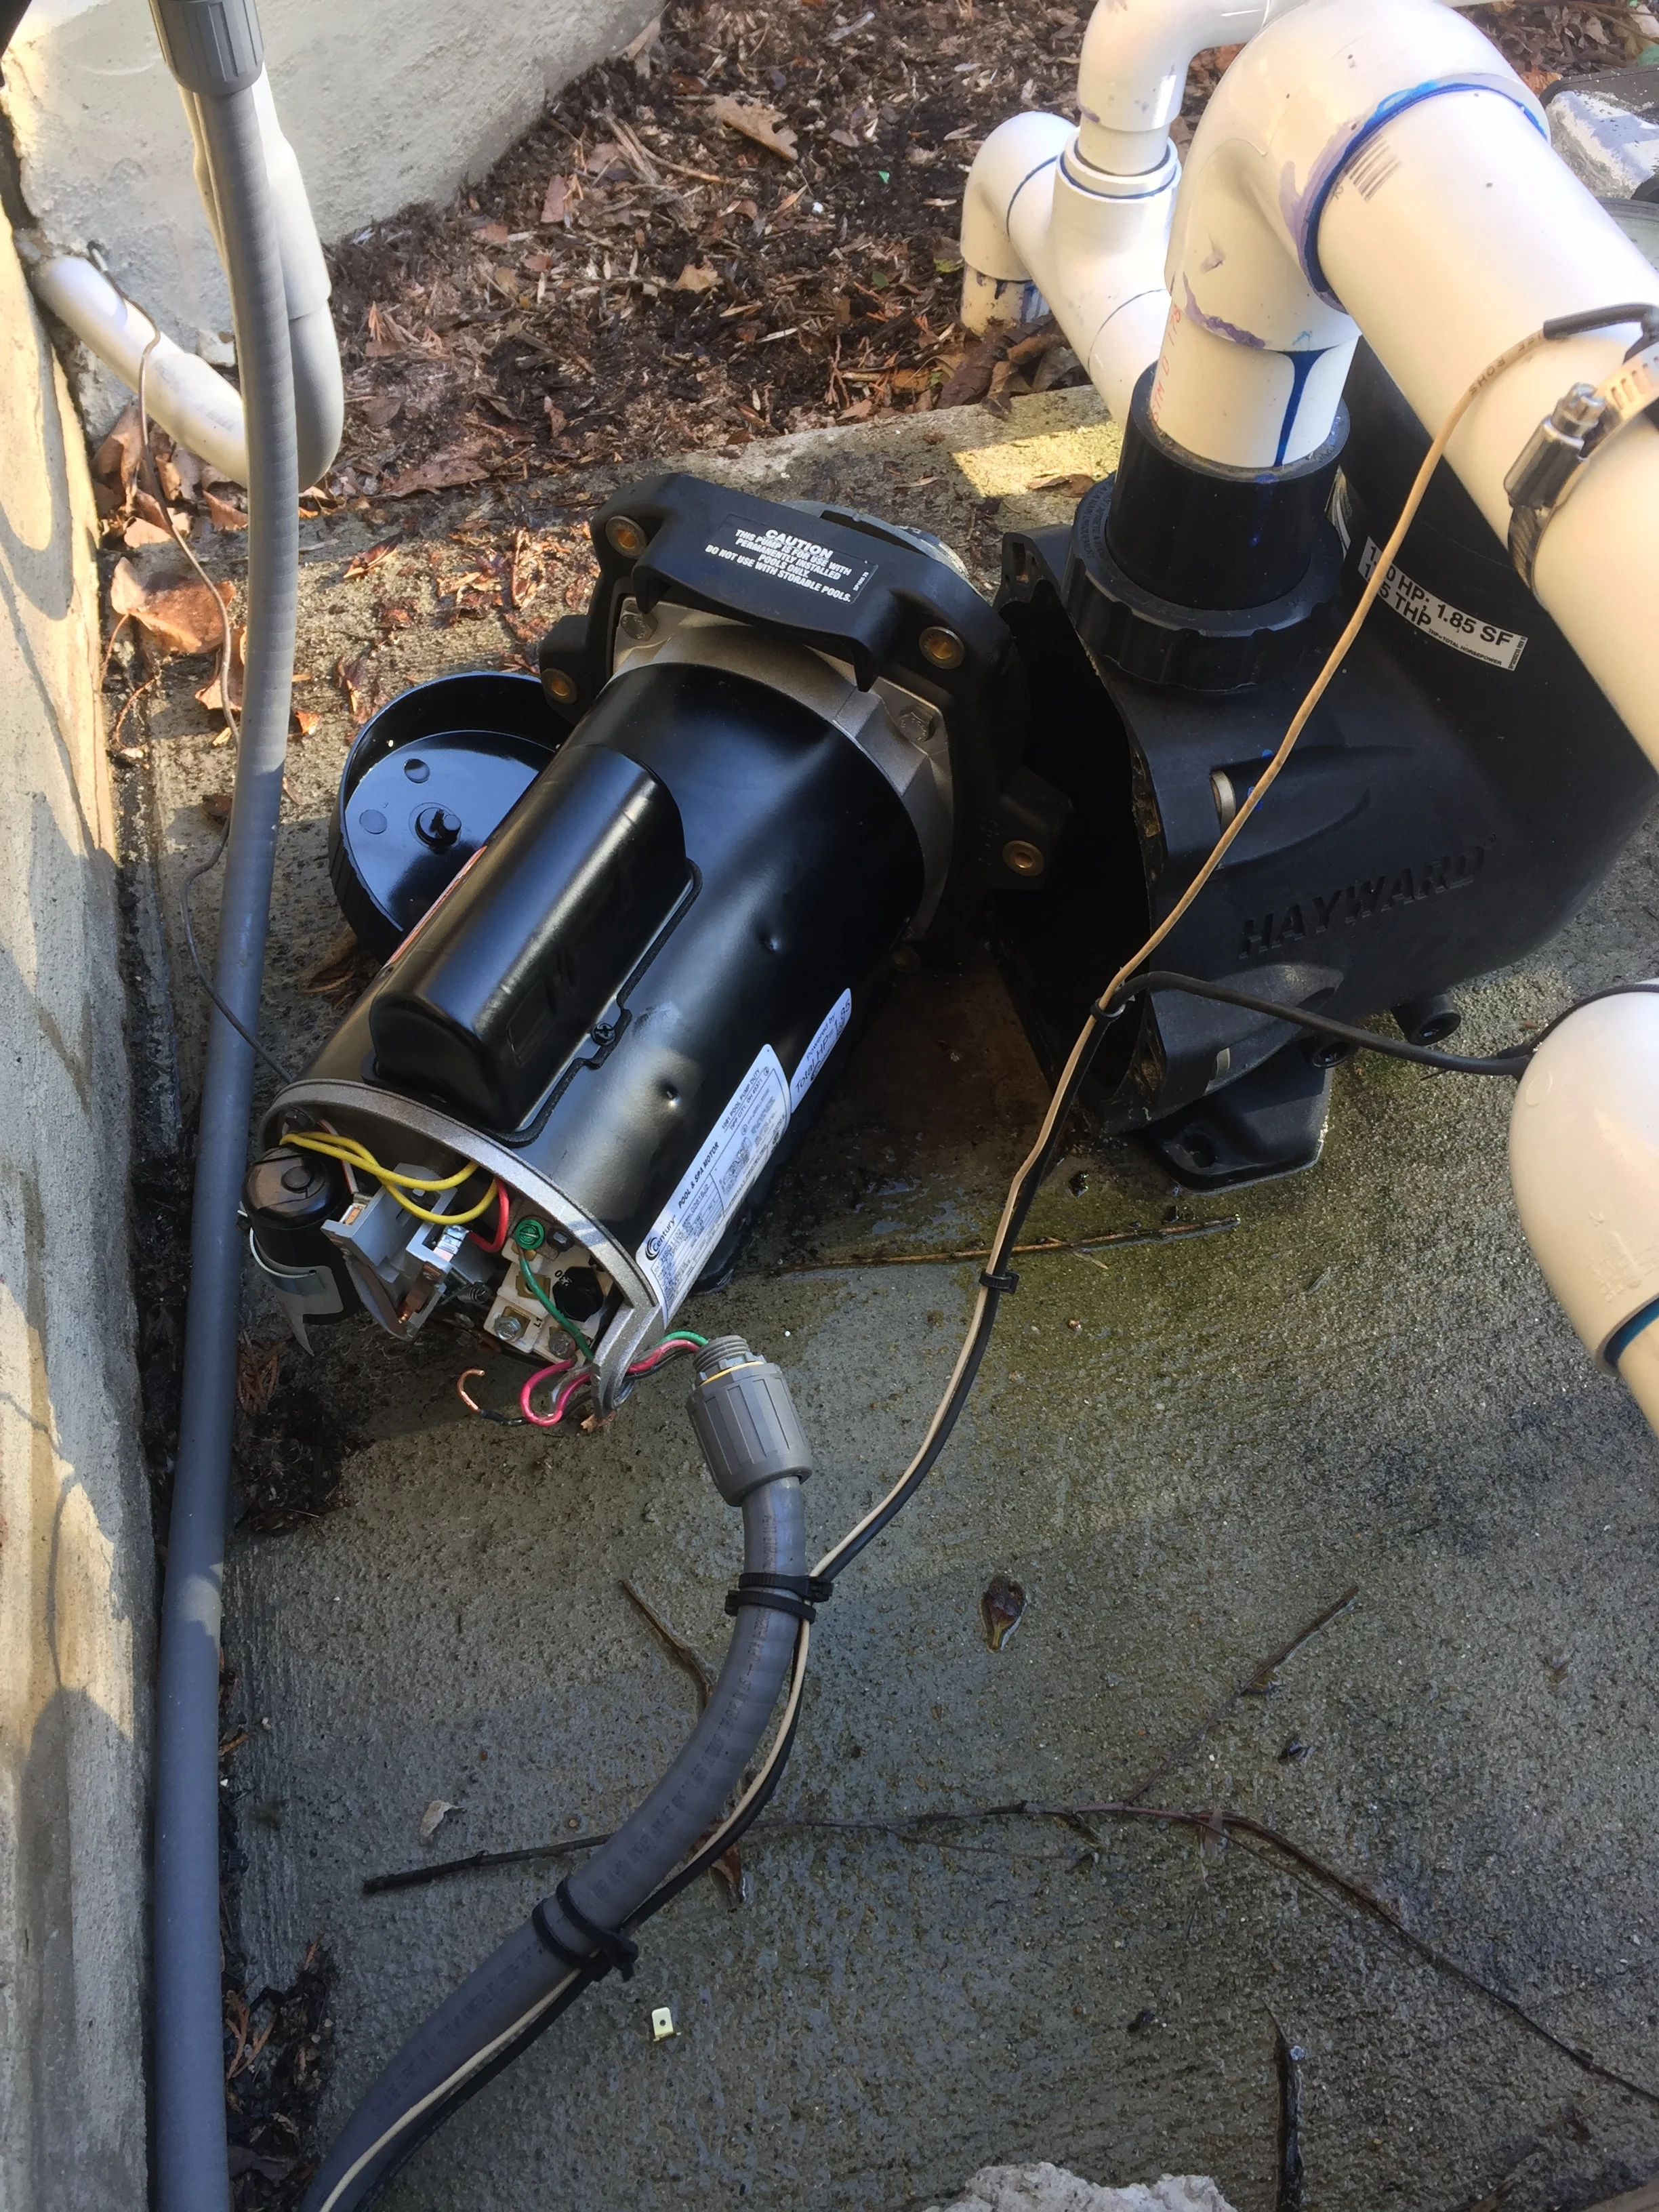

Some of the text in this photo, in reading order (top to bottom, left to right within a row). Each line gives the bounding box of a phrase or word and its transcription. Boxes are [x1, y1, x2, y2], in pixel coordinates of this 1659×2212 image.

[735, 529, 852, 575] THIS PUMP IS FOR USE WITH
[735, 537, 841, 579] PERMANENTLY INSTALLED
[758, 554, 810, 577] POOLS ONLY.
[765, 529, 833, 559] CAUTION
[705, 544, 851, 602] DO NOT USE WITH STORABLE POOLS.
[1364, 563, 1432, 628] 15 THP
[1369, 545, 1397, 583] 1.0
[1437, 603, 1477, 634] 1.85
[1479, 625, 1514, 647] SF
[1460, 644, 1502, 666] HORSEPOWER
[1239, 845, 1485, 960] HAYWARD
[806, 1023, 829, 1061] Powered
[828, 1012, 836, 1025] by
[729, 1101, 741, 1116] POOL
[739, 1083, 750, 1101] PUMP
[749, 1068, 759, 1084] DUTY
[795, 1058, 815, 1093] Total
[652, 1217, 676, 1253] Century
[678, 1189, 691, 1209] POOL
[690, 1181, 696, 1189] &
[694, 1166, 703, 1183] SPA
[703, 1141, 718, 1168] MOTOR
[554, 1269, 573, 1287] 230
[533, 1317, 543, 1328] L1
